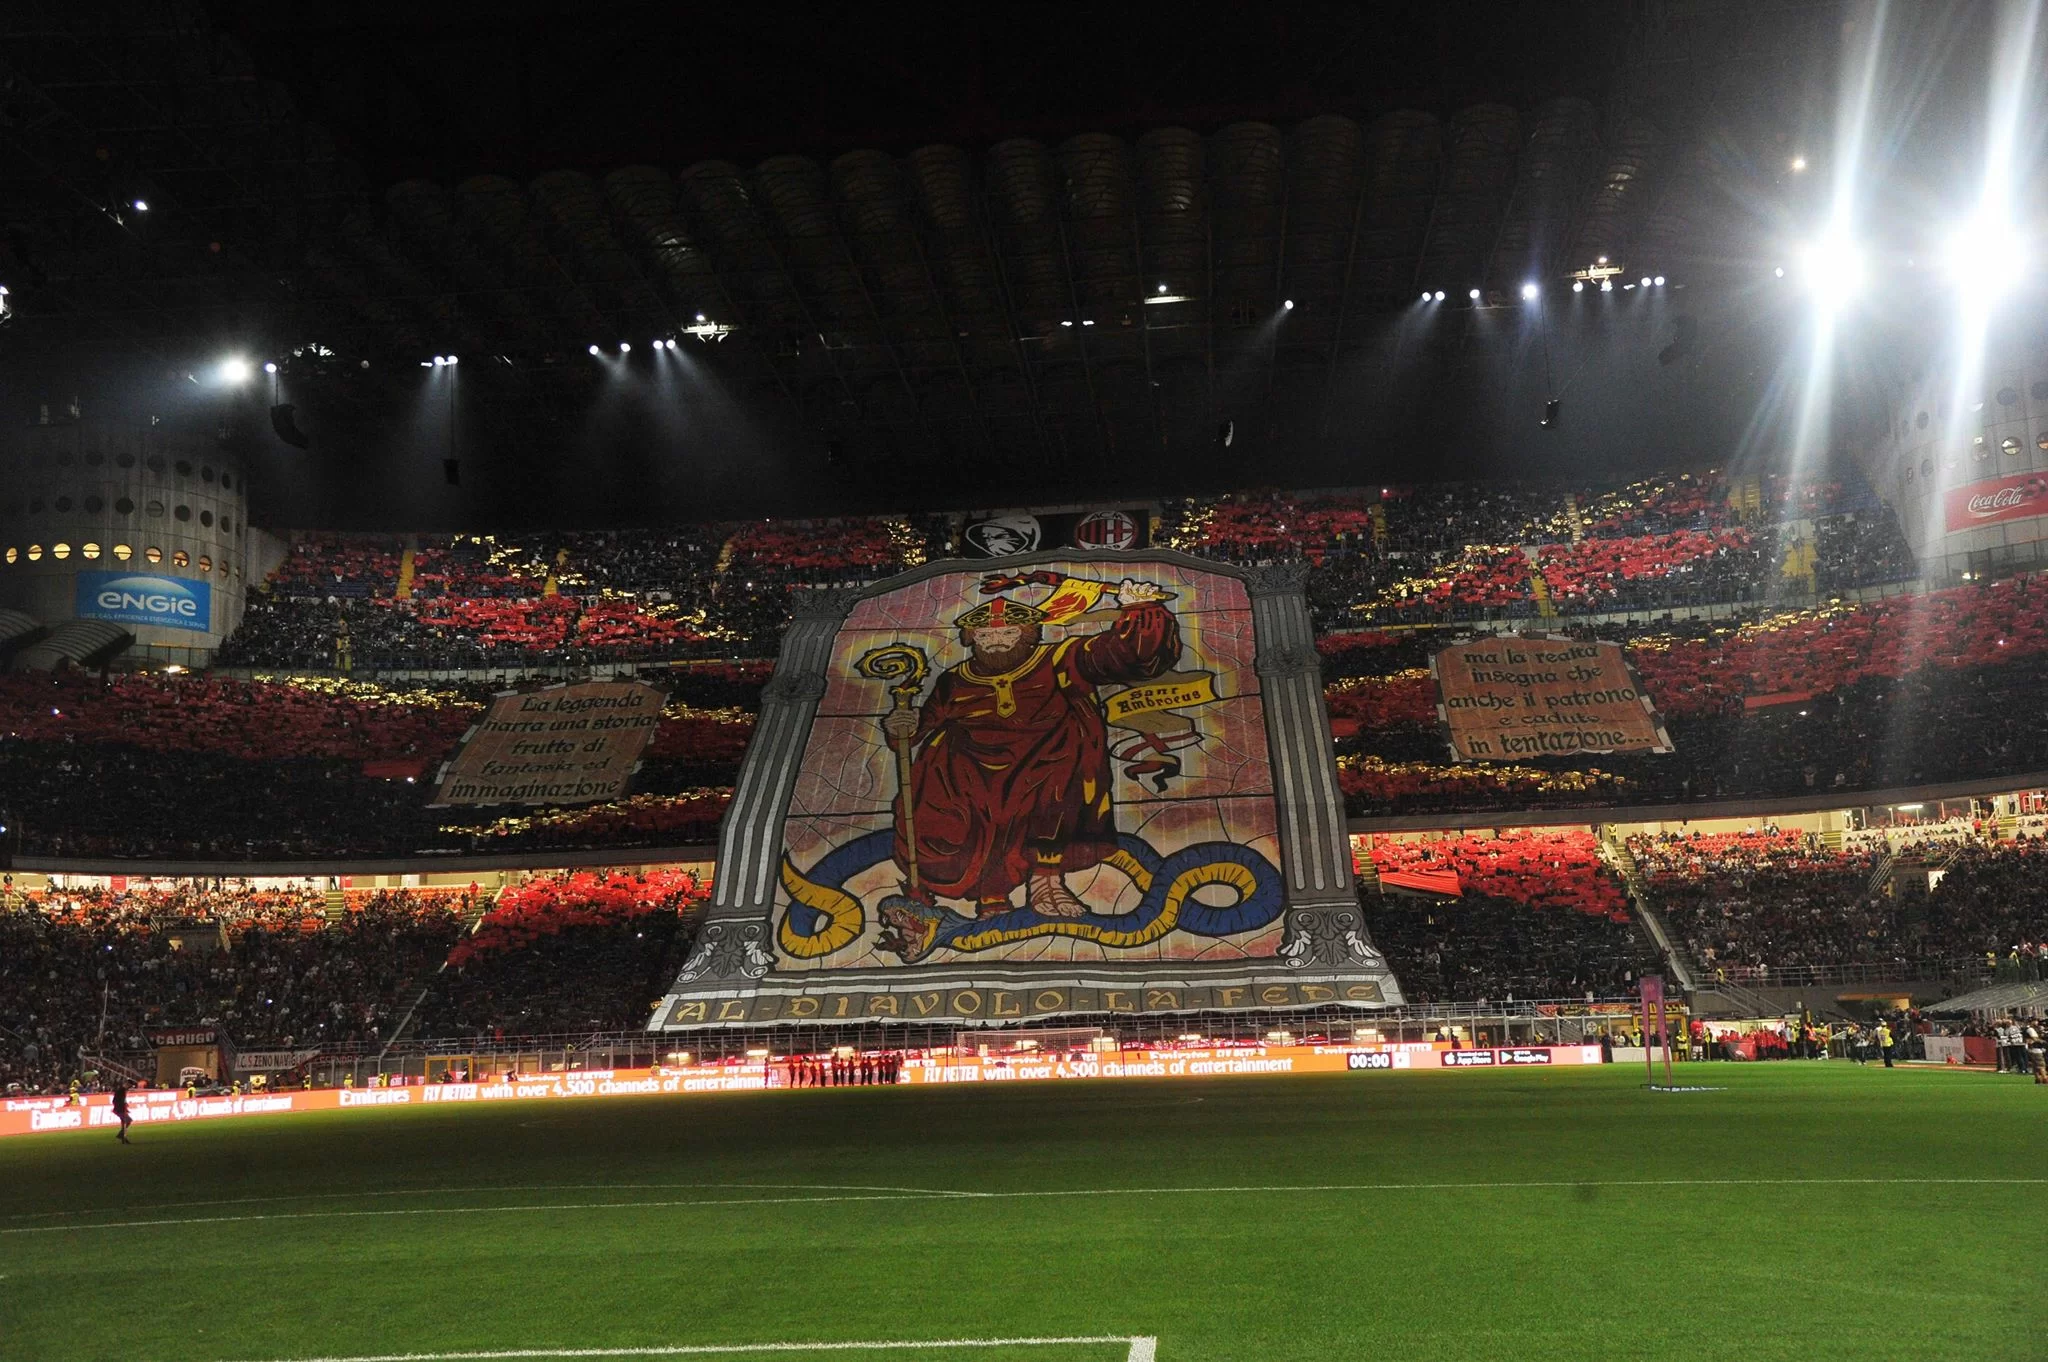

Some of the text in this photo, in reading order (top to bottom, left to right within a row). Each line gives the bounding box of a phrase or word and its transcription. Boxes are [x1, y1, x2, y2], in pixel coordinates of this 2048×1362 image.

[1968, 485, 2024, 514] Coca-Cola
[1464, 653, 1497, 664] ma
[1507, 649, 1526, 664] la
[1472, 665, 1603, 687] insegna che
[520, 690, 644, 713] La leggenda
[1116, 690, 1202, 714] Ambroeus
[1448, 688, 1636, 711] anche il patrono
[483, 713, 654, 733] narra una storia
[511, 737, 606, 755] frutto di
[1468, 736, 1491, 754] in
[481, 757, 611, 776] fantasia ed
[449, 777, 621, 800] immaginazione
[1213, 984, 1377, 1008] FEDE
[156, 1031, 216, 1046] CARUGO
[1349, 1053, 1390, 1069] 00:00
[1457, 1056, 1492, 1066] App Store
[1514, 1053, 1549, 1064] Google Play
[924, 1066, 941, 1083] FLY
[943, 1065, 979, 1082] BETTER
[983, 1066, 1016, 1081] with
[1020, 1066, 1052, 1079] over
[1102, 1061, 1165, 1077] channels
[1169, 1060, 1186, 1076] of
[1190, 1057, 1294, 1073] entertainment
[340, 1089, 410, 1106] Emirates
[481, 1084, 513, 1099] with
[517, 1084, 550, 1097] over
[553, 1080, 596, 1098] 4,500
[599, 1077, 660, 1094] channels
[663, 1076, 680, 1091] of
